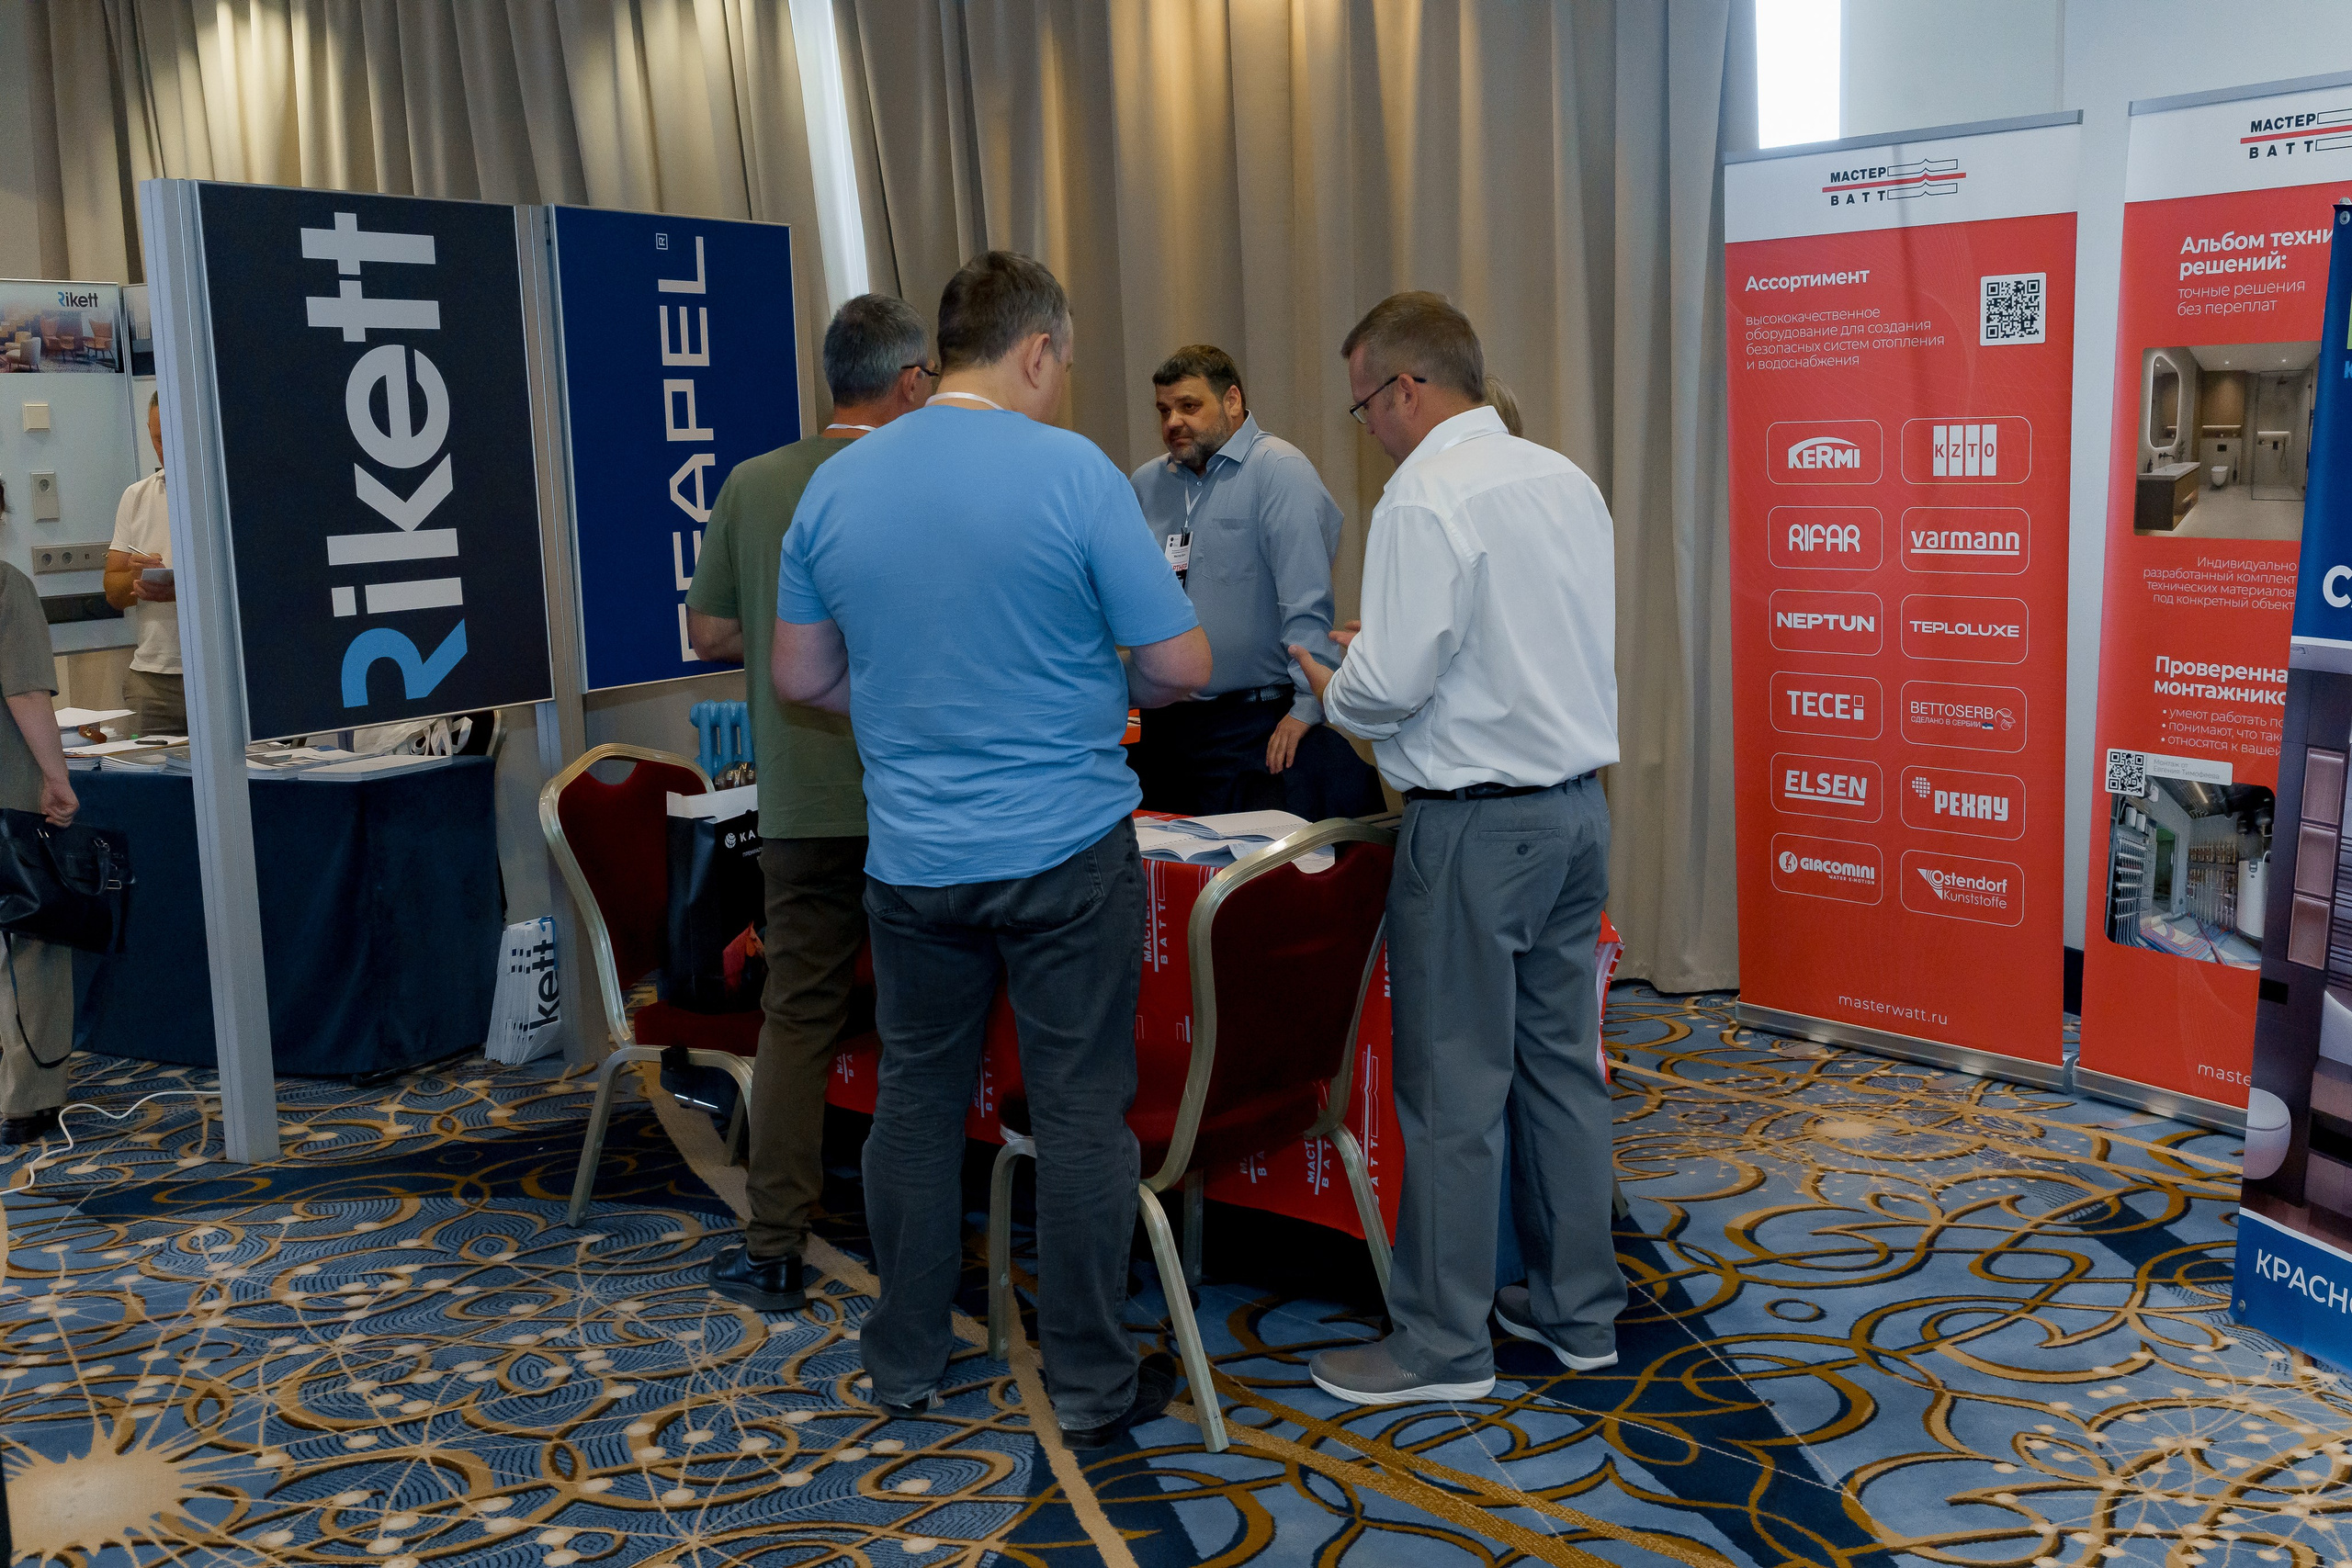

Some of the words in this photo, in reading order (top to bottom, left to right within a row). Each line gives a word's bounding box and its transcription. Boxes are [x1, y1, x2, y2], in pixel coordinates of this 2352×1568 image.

[2250, 113, 2316, 133] МАСТЕР
[2249, 140, 2313, 159] ВАТТ
[1830, 166, 1886, 183] МАСТЕР
[1830, 190, 1885, 206] ВАТТ
[2180, 231, 2265, 254] Альбом
[2270, 229, 2334, 247] техни
[2179, 251, 2287, 280] решений:
[1745, 269, 1870, 292] Ассортимент
[2178, 285, 2231, 299] точные
[2233, 280, 2305, 299] решения
[58, 291, 98, 308] Rikett
[2177, 302, 2201, 316] без
[2205, 299, 2278, 316] переплат
[1746, 307, 1881, 326] высококачественное
[1746, 325, 1838, 343] оборудование
[1840, 323, 1865, 337] для
[1868, 320, 1931, 334] создания
[1746, 340, 1821, 356] безопасных
[1824, 341, 1870, 353] систем
[1872, 334, 1944, 350] отопления
[1747, 360, 1755, 370] и
[1758, 355, 1860, 371] водоснабжения
[300, 211, 468, 708] Rikett
[1788, 436, 1860, 469] KERMI
[1788, 524, 1860, 553] RIFAR
[1911, 530, 2020, 550] varmann
[2197, 557, 2297, 572] Индивидуально
[2143, 568, 2233, 582] разработанный
[2236, 572, 2297, 585] комплект
[2147, 581, 2217, 593] технических
[2220, 585, 2295, 599] материалов
[2153, 593, 2174, 605] под
[2177, 594, 2249, 609] конкретный
[2251, 599, 2295, 611] объект
[1777, 612, 1875, 632] NEPTUN
[1910, 621, 2019, 637] TEPLOLUXE
[2155, 655, 2288, 683] Проверенна
[2154, 680, 2286, 705] монтажнико
[1786, 690, 1851, 719] TECE
[1910, 701, 1994, 719] BETTOSERB
[1911, 716, 1944, 725] СДЕЛАНО
[1951, 719, 1981, 728] СЕРБИИ
[2168, 708, 2209, 720] умеют
[2211, 711, 2267, 727] работать
[2168, 722, 2234, 739] понимают,
[2236, 728, 2258, 740] что
[2260, 732, 2283, 742] так
[2167, 736, 2228, 750] относятся
[2231, 743, 2238, 751] к
[1784, 770, 1868, 799] ELSEN
[1800, 857, 1875, 879] GIACOMINI
[1931, 868, 2007, 895] Ostendorf
[1943, 888, 2007, 909] Kunststoffe
[529, 939, 560, 1032] kett
[1838, 995, 1948, 1026] masterwatt.ru
[2198, 1063, 2252, 1088] maste
[1305, 1141, 1317, 1183] МАСТ
[1321, 1140, 1332, 1188] ВАТ
